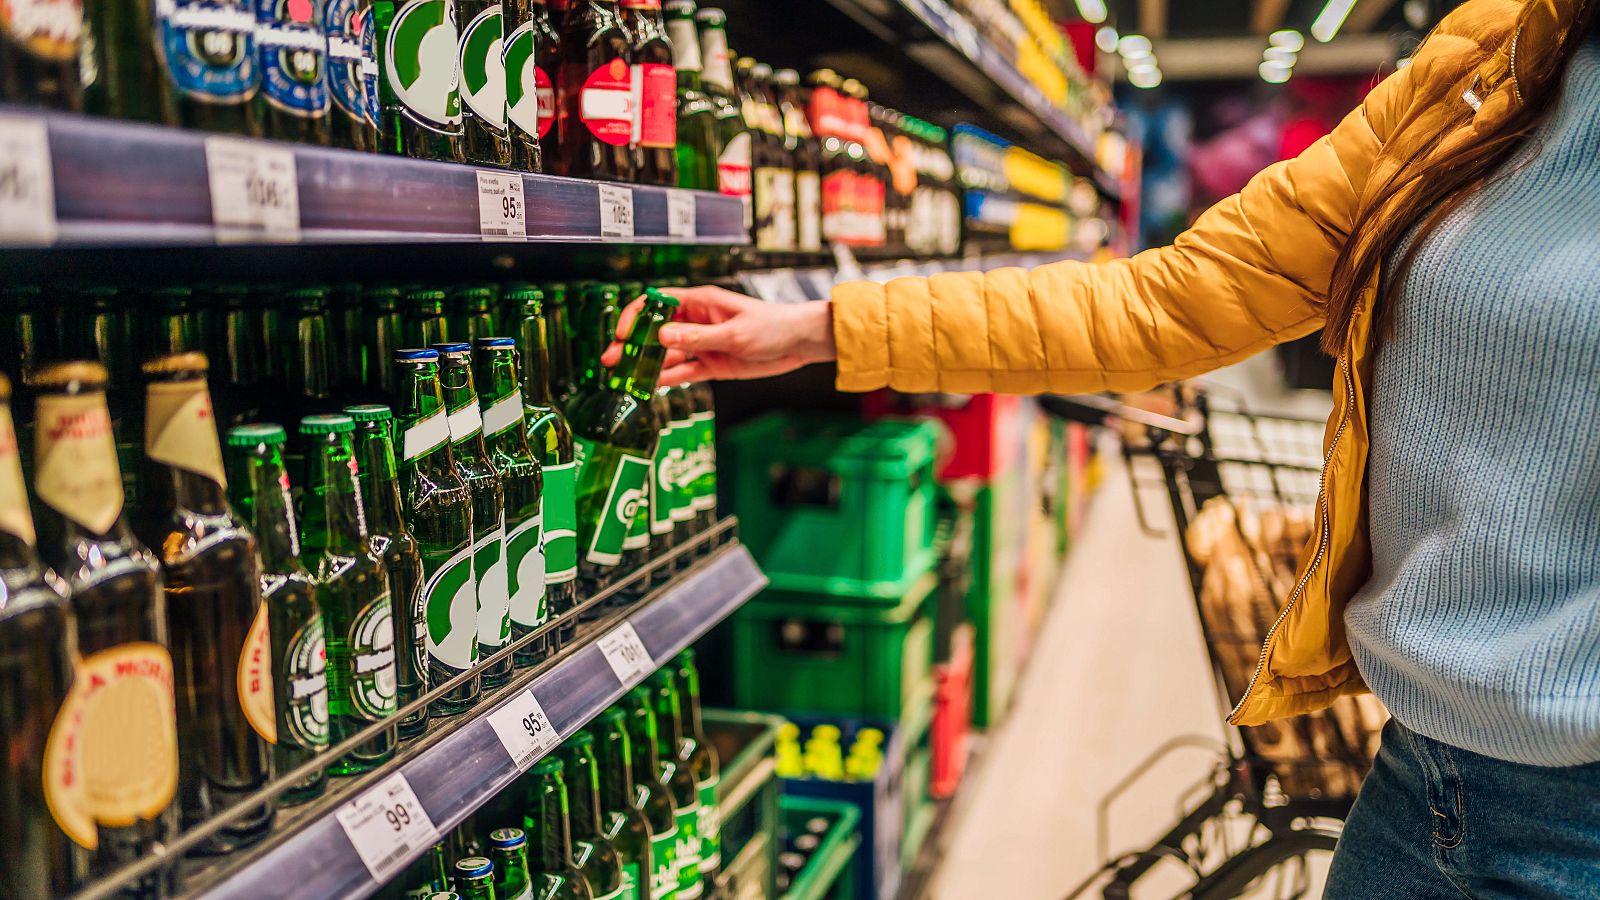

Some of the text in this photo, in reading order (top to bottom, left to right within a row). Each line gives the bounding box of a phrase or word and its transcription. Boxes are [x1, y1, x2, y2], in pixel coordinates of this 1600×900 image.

[502, 196, 517, 219] 95
[522, 712, 542, 737] 95
[385, 803, 411, 832] 99
